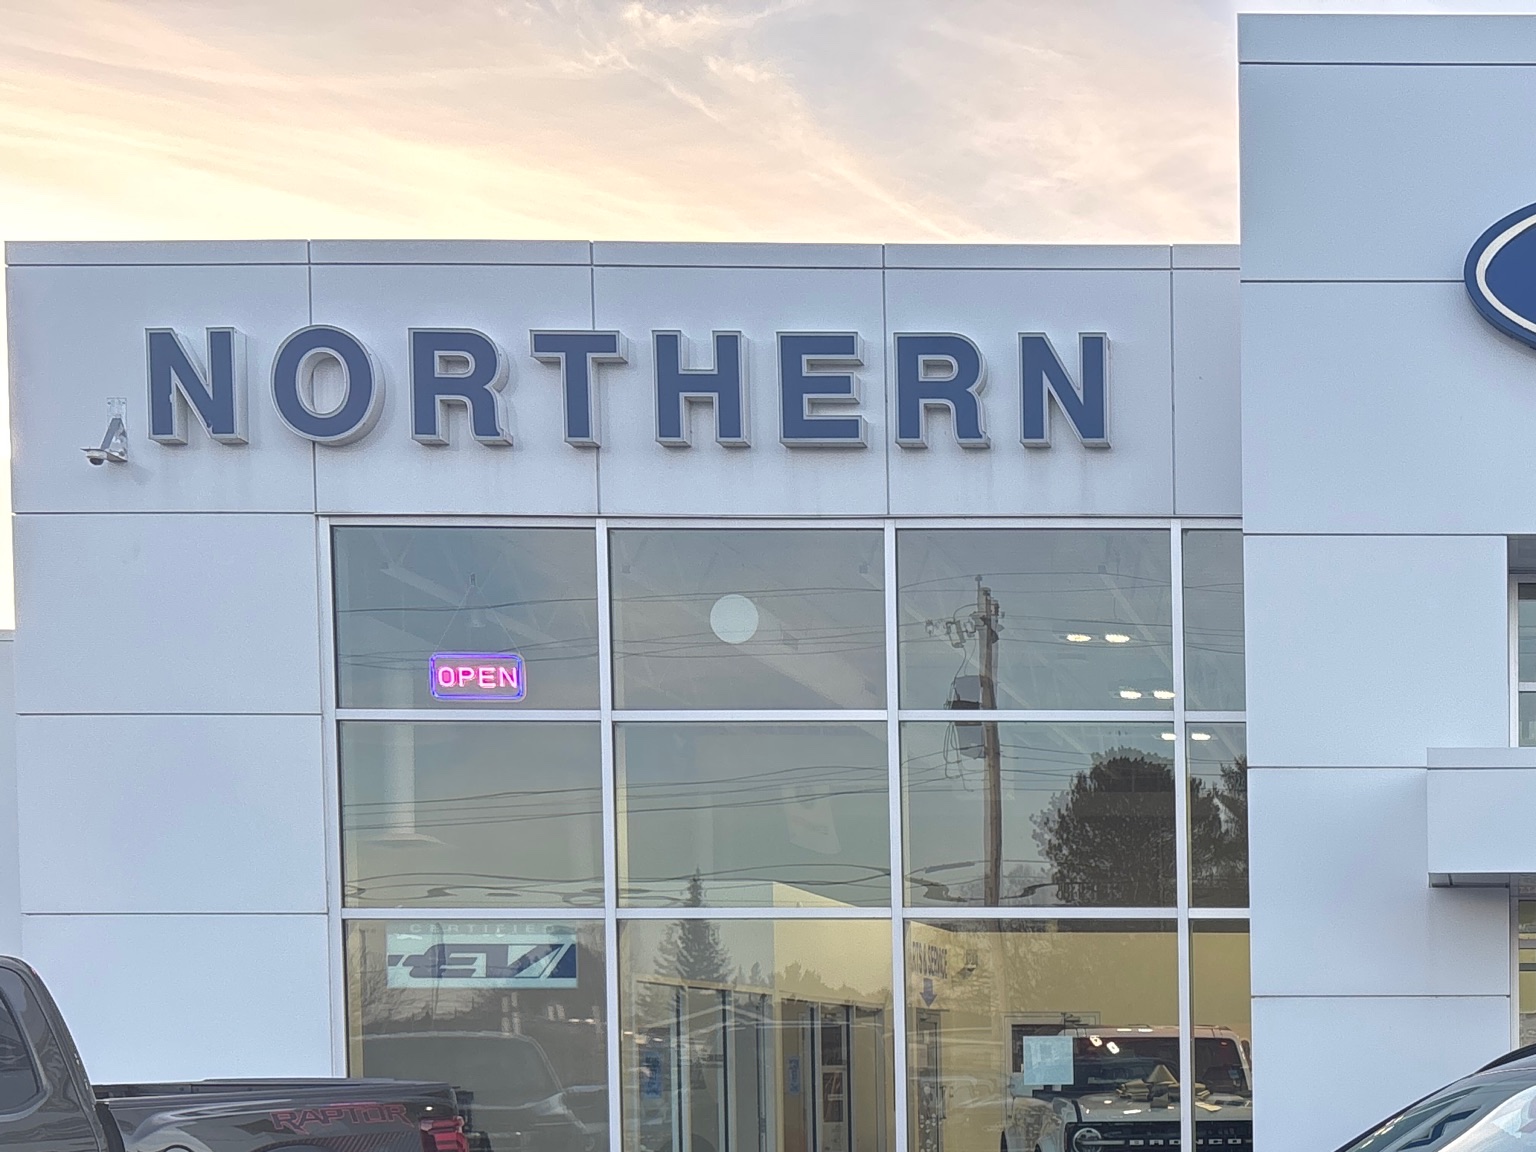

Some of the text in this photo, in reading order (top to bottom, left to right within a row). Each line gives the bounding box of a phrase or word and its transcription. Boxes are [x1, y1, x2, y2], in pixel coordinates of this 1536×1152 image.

[145, 325, 1112, 450] NORTHERN
[437, 666, 518, 689] OPEN
[270, 1103, 415, 1136] RAPTOR
